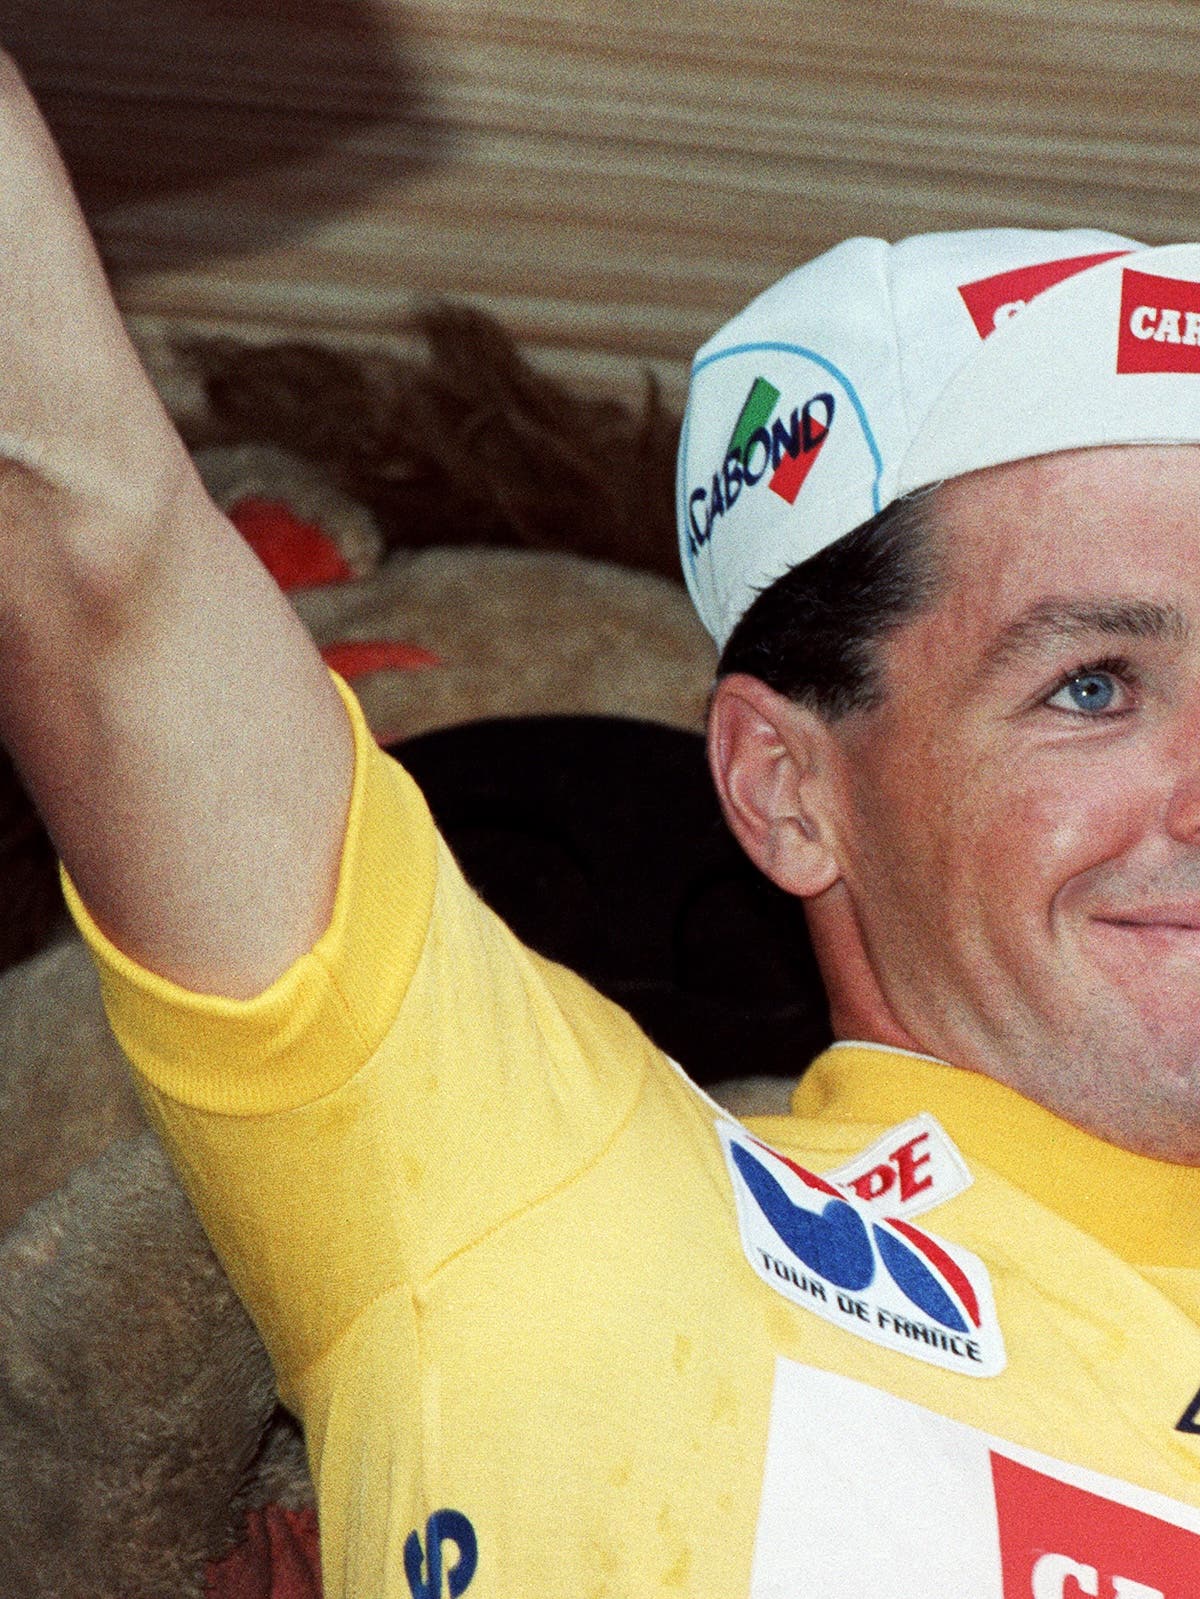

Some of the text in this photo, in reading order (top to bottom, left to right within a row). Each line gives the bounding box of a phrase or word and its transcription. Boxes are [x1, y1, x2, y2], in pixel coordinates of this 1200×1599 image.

[757, 1247, 983, 1363] TOUR DE FRANCE
